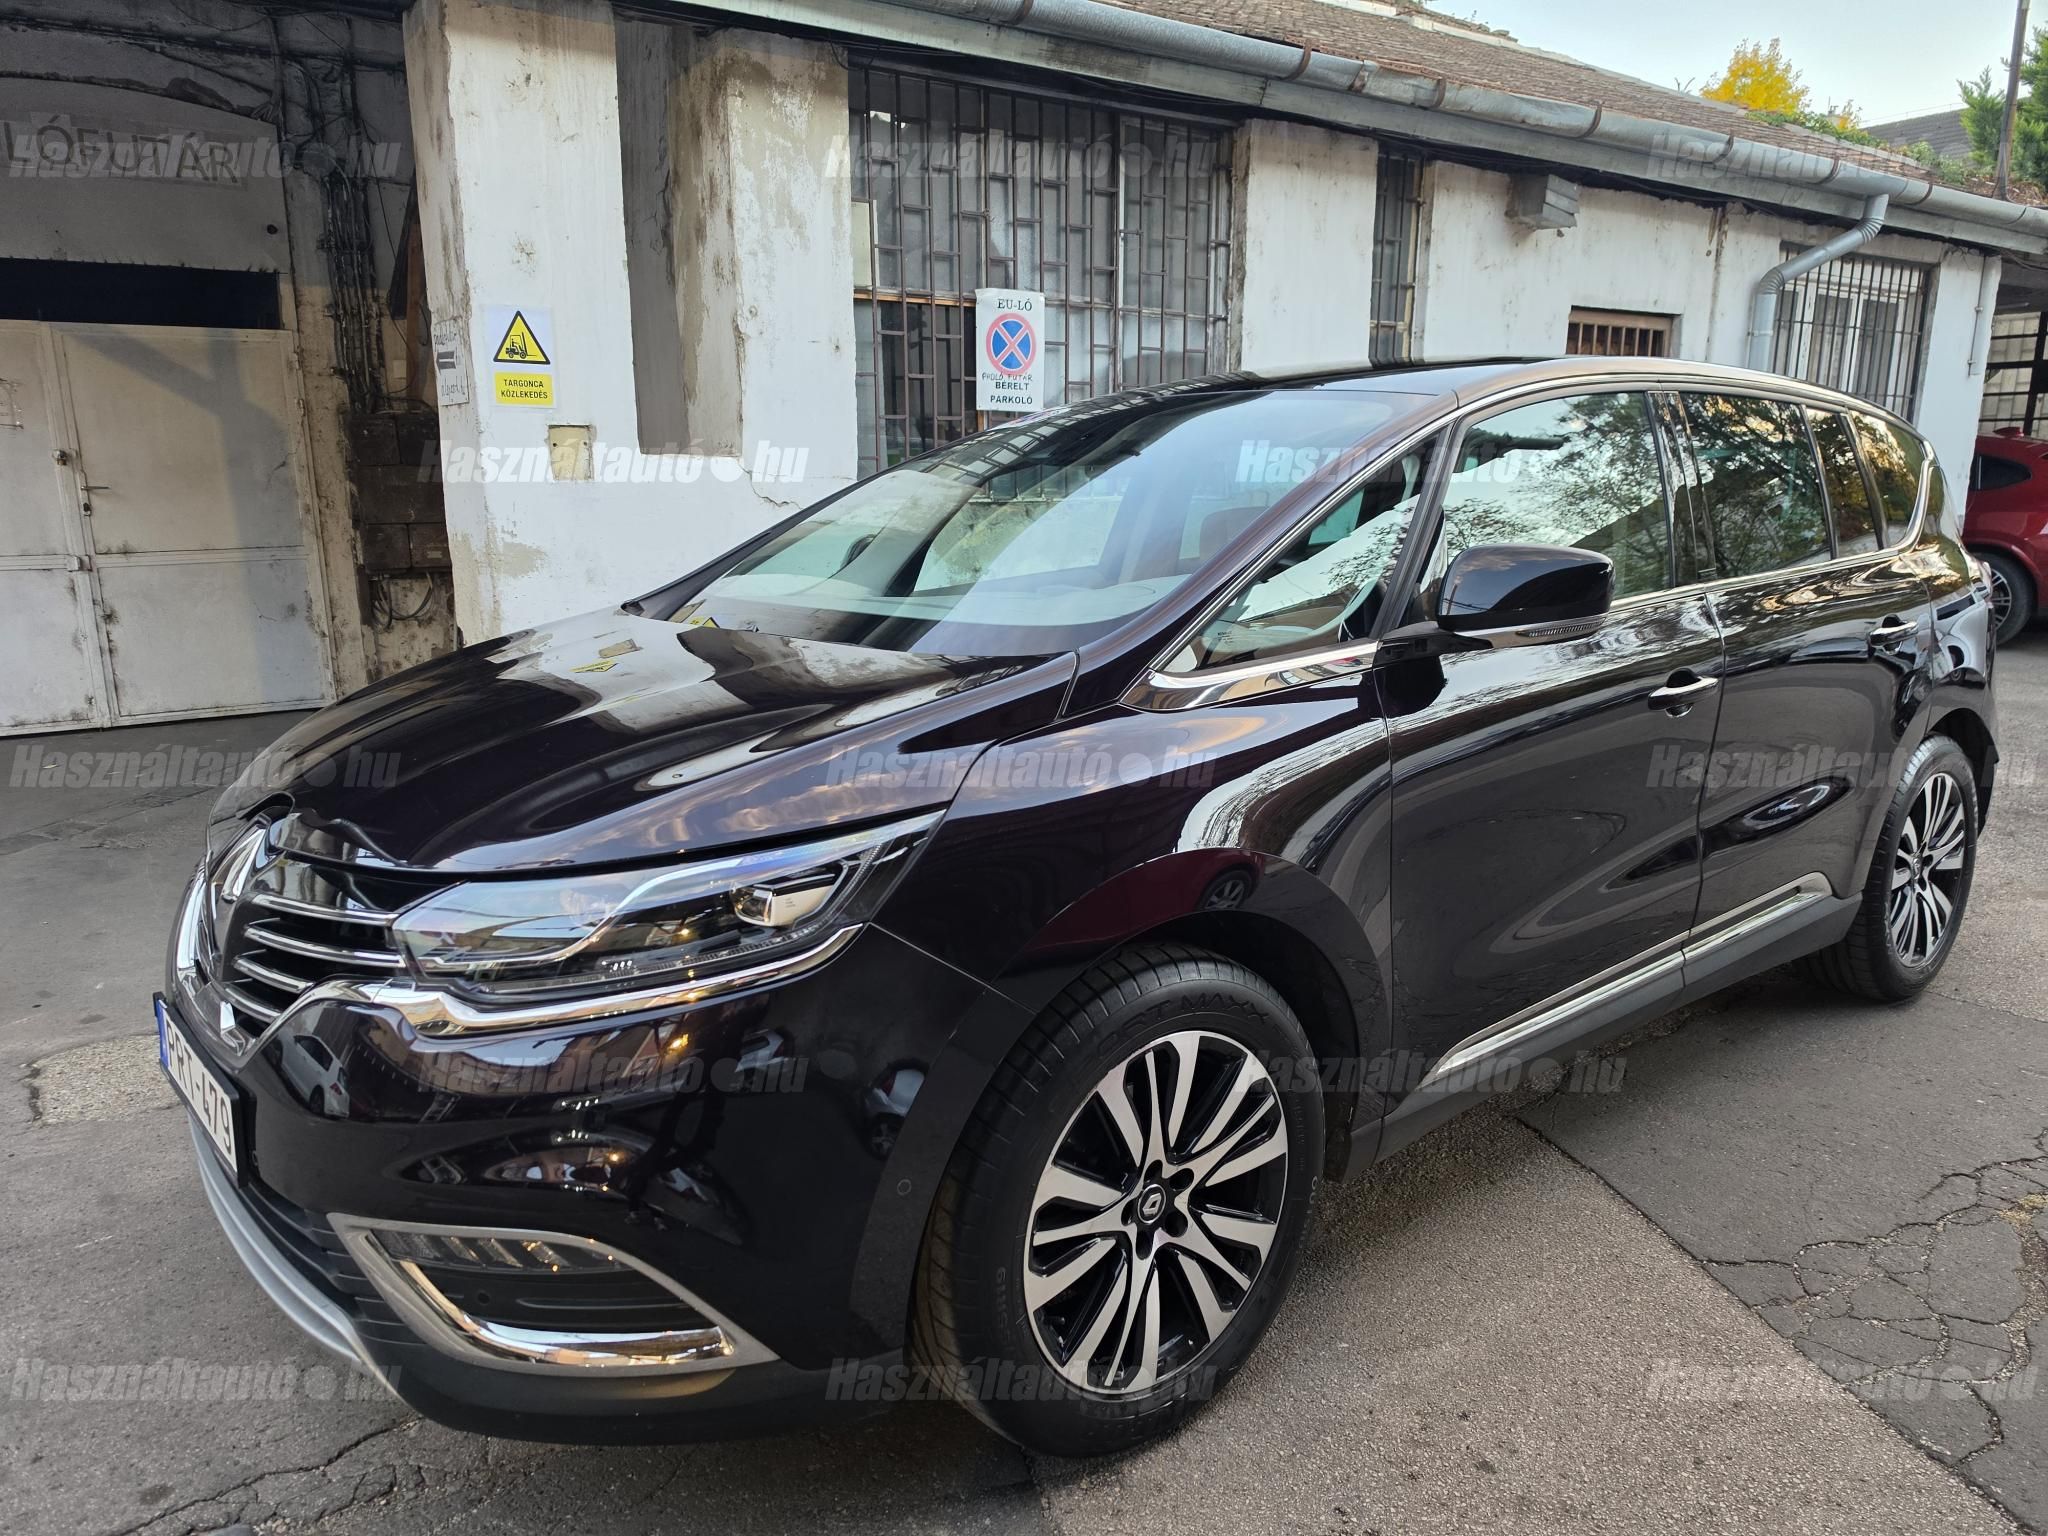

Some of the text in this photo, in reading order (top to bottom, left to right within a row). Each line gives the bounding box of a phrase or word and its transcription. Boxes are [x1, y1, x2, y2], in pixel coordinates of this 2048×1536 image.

[997, 298, 1033, 311] EU-LÓ
[503, 378, 544, 388] TARGONCA
[501, 389, 548, 399] KÖZLEKEDÉS
[166, 1018, 232, 1155] PRT-479
